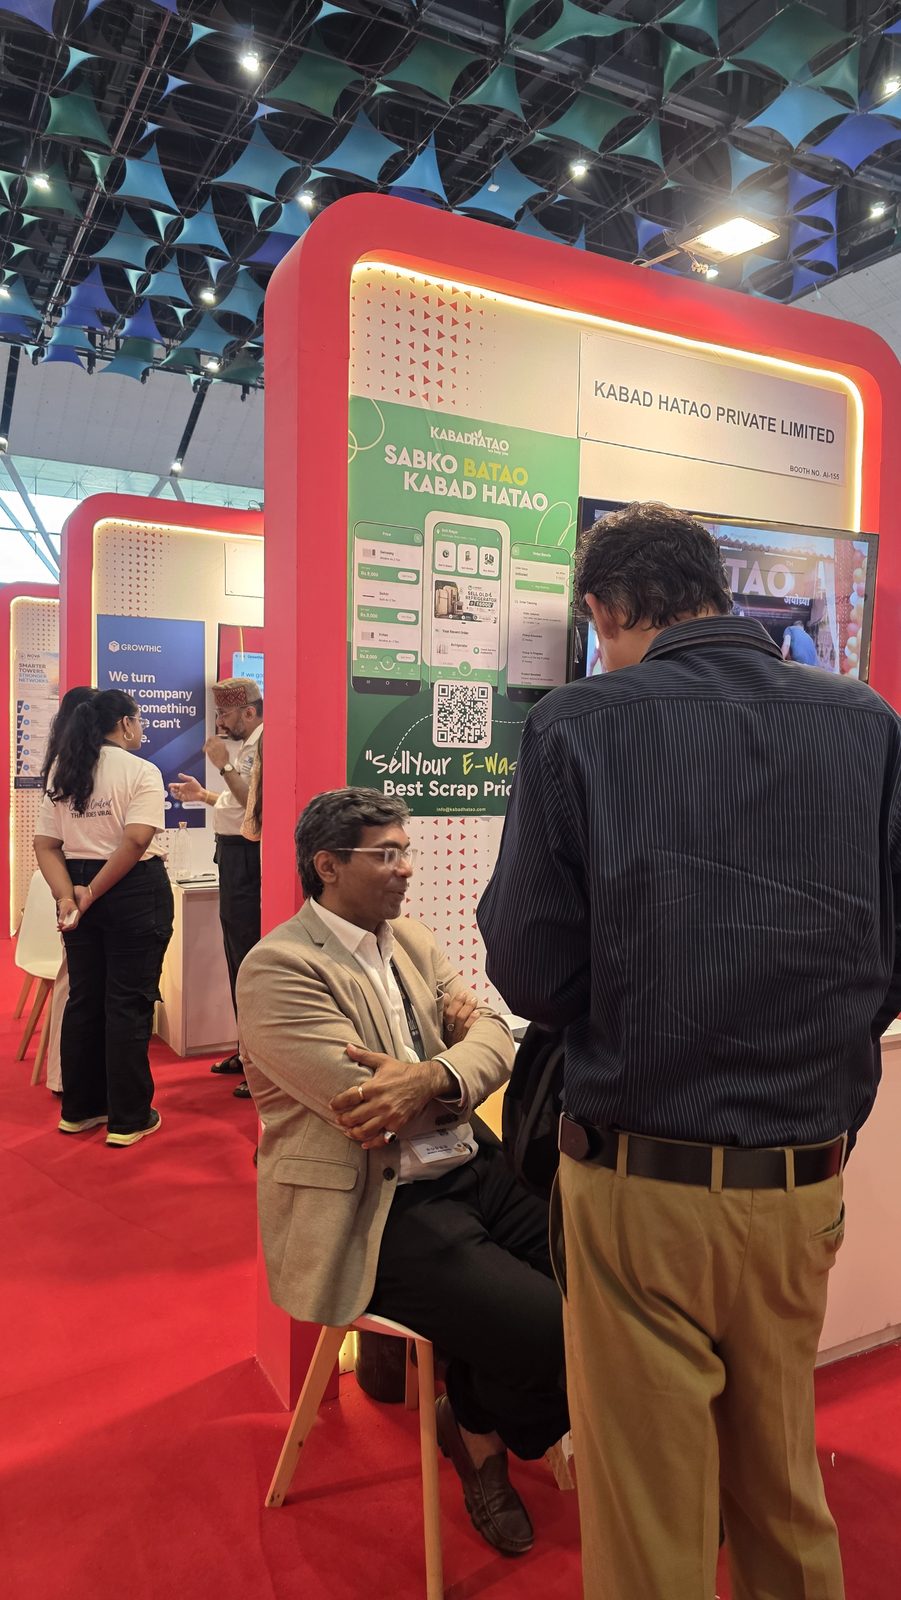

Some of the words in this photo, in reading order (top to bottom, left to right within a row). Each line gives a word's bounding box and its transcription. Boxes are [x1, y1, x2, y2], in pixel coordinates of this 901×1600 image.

[594, 380, 653, 407] KABAD
[658, 394, 712, 418] HATAO
[716, 406, 776, 433] PRIVATE
[780, 420, 835, 444] LIMITED
[430, 426, 510, 452] KABADHATAO
[384, 444, 458, 474] SABKO
[464, 458, 528, 486] BATAO
[790, 465, 810, 474] BOOTH
[822, 471, 840, 480] AI-155
[404, 471, 476, 500] KABAD
[482, 484, 548, 511] HATAO
[726, 558, 795, 598] TAO
[121, 644, 161, 652] GROWTHIC
[109, 671, 128, 682] We
[131, 672, 155, 683] turn
[139, 689, 192, 701] company
[152, 718, 181, 728] can't
[462, 752, 518, 776] E-Was
[384, 780, 424, 796] Best
[429, 780, 478, 800] Scrap
[484, 780, 512, 796] Pric
